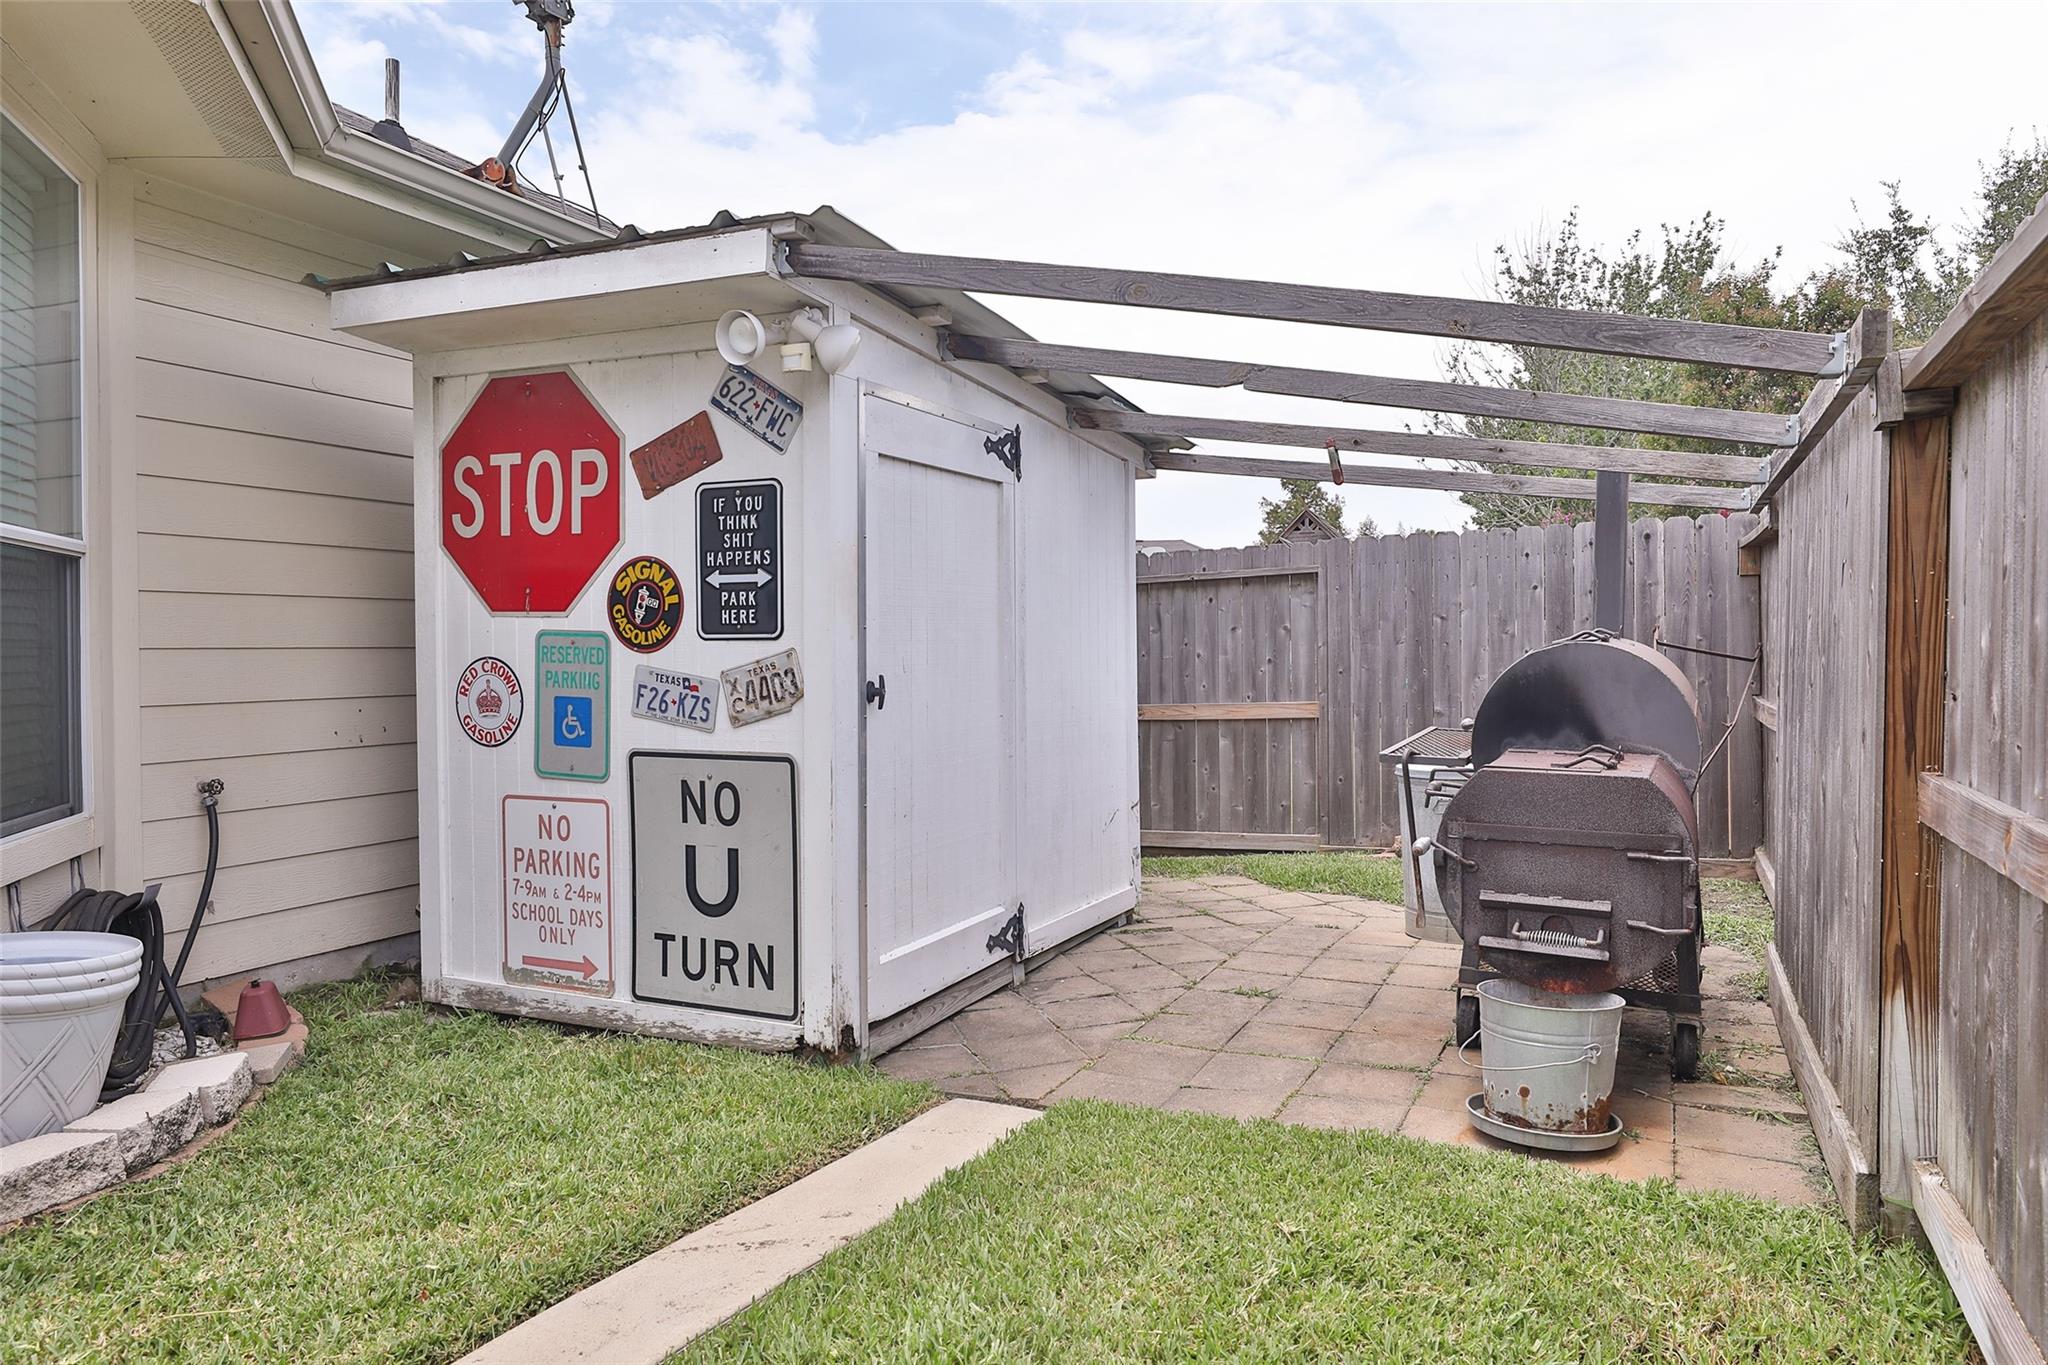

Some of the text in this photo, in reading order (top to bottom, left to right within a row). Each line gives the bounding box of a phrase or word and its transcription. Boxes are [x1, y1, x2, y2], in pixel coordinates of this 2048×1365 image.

[451, 448, 609, 539] STOP
[713, 495, 763, 512] IF YOU
[718, 514, 758, 531] THINK
[723, 532, 754, 548] SHIT
[706, 550, 771, 567] HAPPENS
[615, 561, 679, 611] SIGNAL
[721, 591, 756, 606] PARK
[612, 603, 671, 645] GASOLINE
[721, 609, 756, 625] HERE
[541, 645, 605, 665] RESERVED
[459, 660, 519, 698] RED CROWN
[545, 670, 601, 690] PARKING
[655, 673, 681, 687] TEXAS
[747, 661, 777, 678] TEXAS
[636, 684, 671, 714] F26
[462, 712, 518, 745] GASOLINE
[680, 779, 741, 827] NO
[538, 814, 571, 842] NO
[513, 847, 600, 880] PARKING
[512, 878, 602, 905] 7-9AM & 2-4PM
[685, 844, 740, 918] U
[512, 902, 604, 929] SCHOOL DAYS
[538, 925, 576, 946] ONLY
[654, 932, 774, 991] TURN
